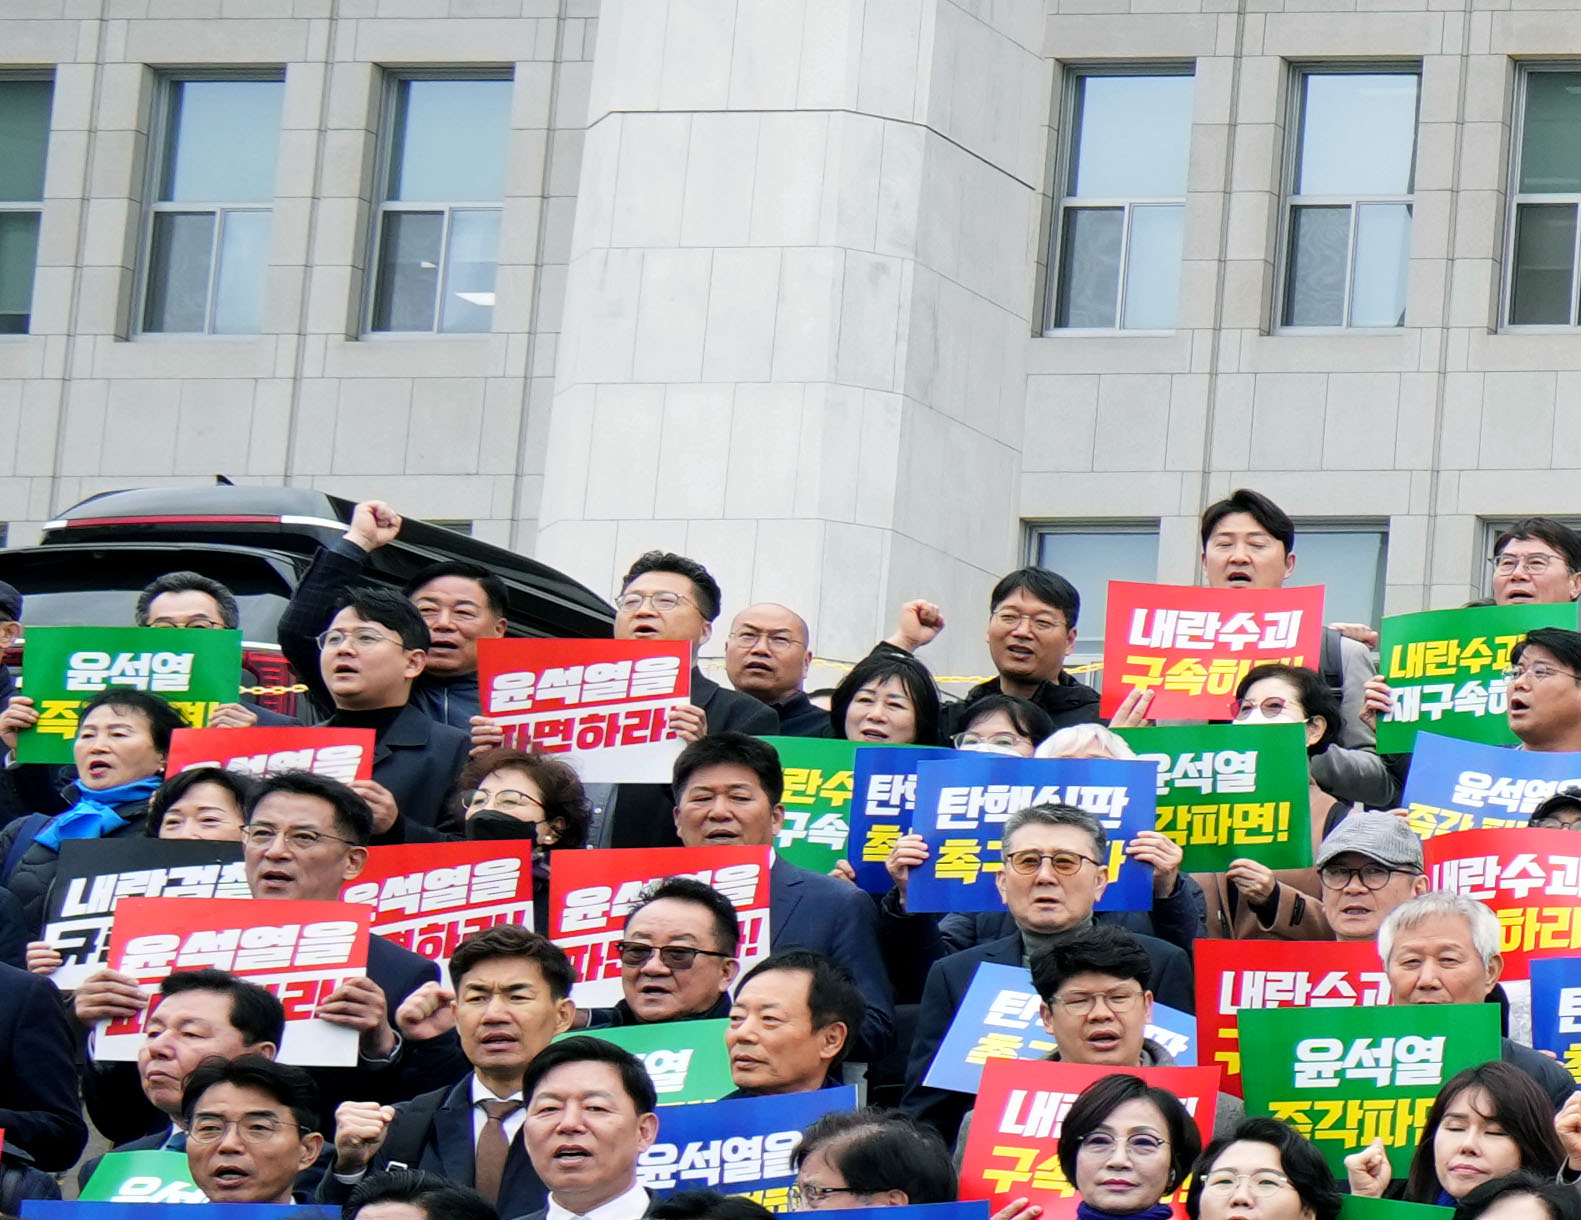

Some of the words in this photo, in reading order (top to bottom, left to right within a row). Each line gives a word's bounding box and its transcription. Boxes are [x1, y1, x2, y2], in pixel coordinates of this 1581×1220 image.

[1130, 609, 1302, 649] 내란수괴
[66, 650, 193, 692] 윤석열
[490, 656, 680, 713] 윤석열을
[1148, 802, 1288, 847] 각파면!
[346, 859, 522, 914] 윤석열을
[121, 920, 355, 976] 윤석열을
[1294, 1035, 1446, 1088] 윤석열
[639, 1131, 802, 1186] 윤석열을
